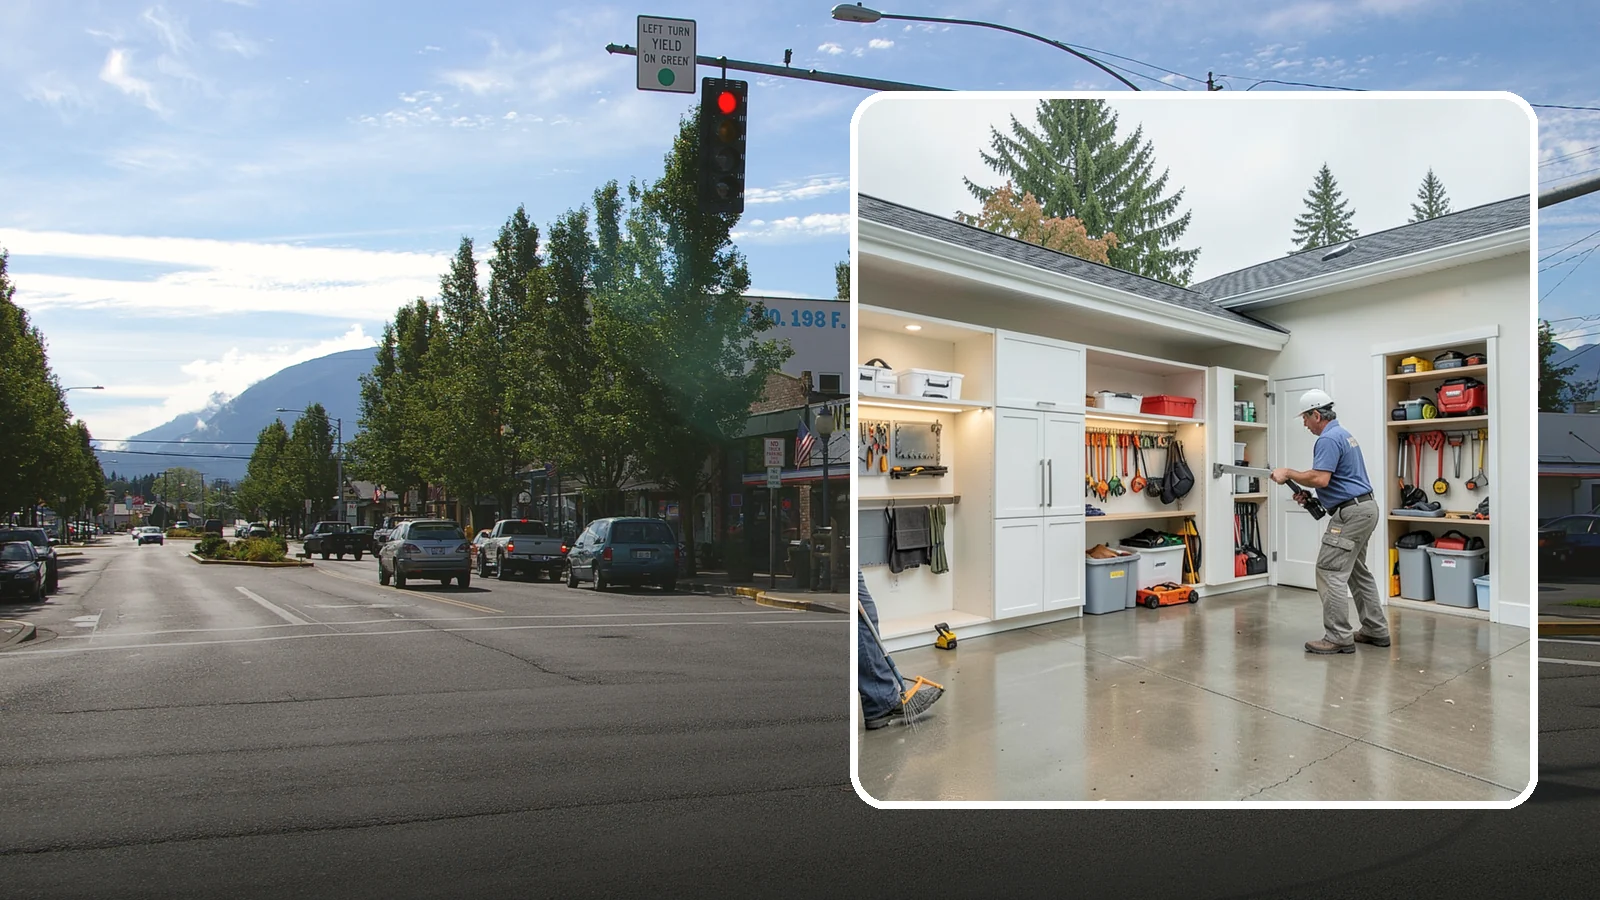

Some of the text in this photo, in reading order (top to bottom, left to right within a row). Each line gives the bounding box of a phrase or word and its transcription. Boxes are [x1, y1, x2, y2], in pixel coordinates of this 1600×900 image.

[643, 23, 690, 37] LEFT TURN
[652, 38, 682, 52] YIELD
[644, 53, 689, 66] ON GREEN
[791, 309, 826, 328] 198
[831, 311, 846, 329] F.
